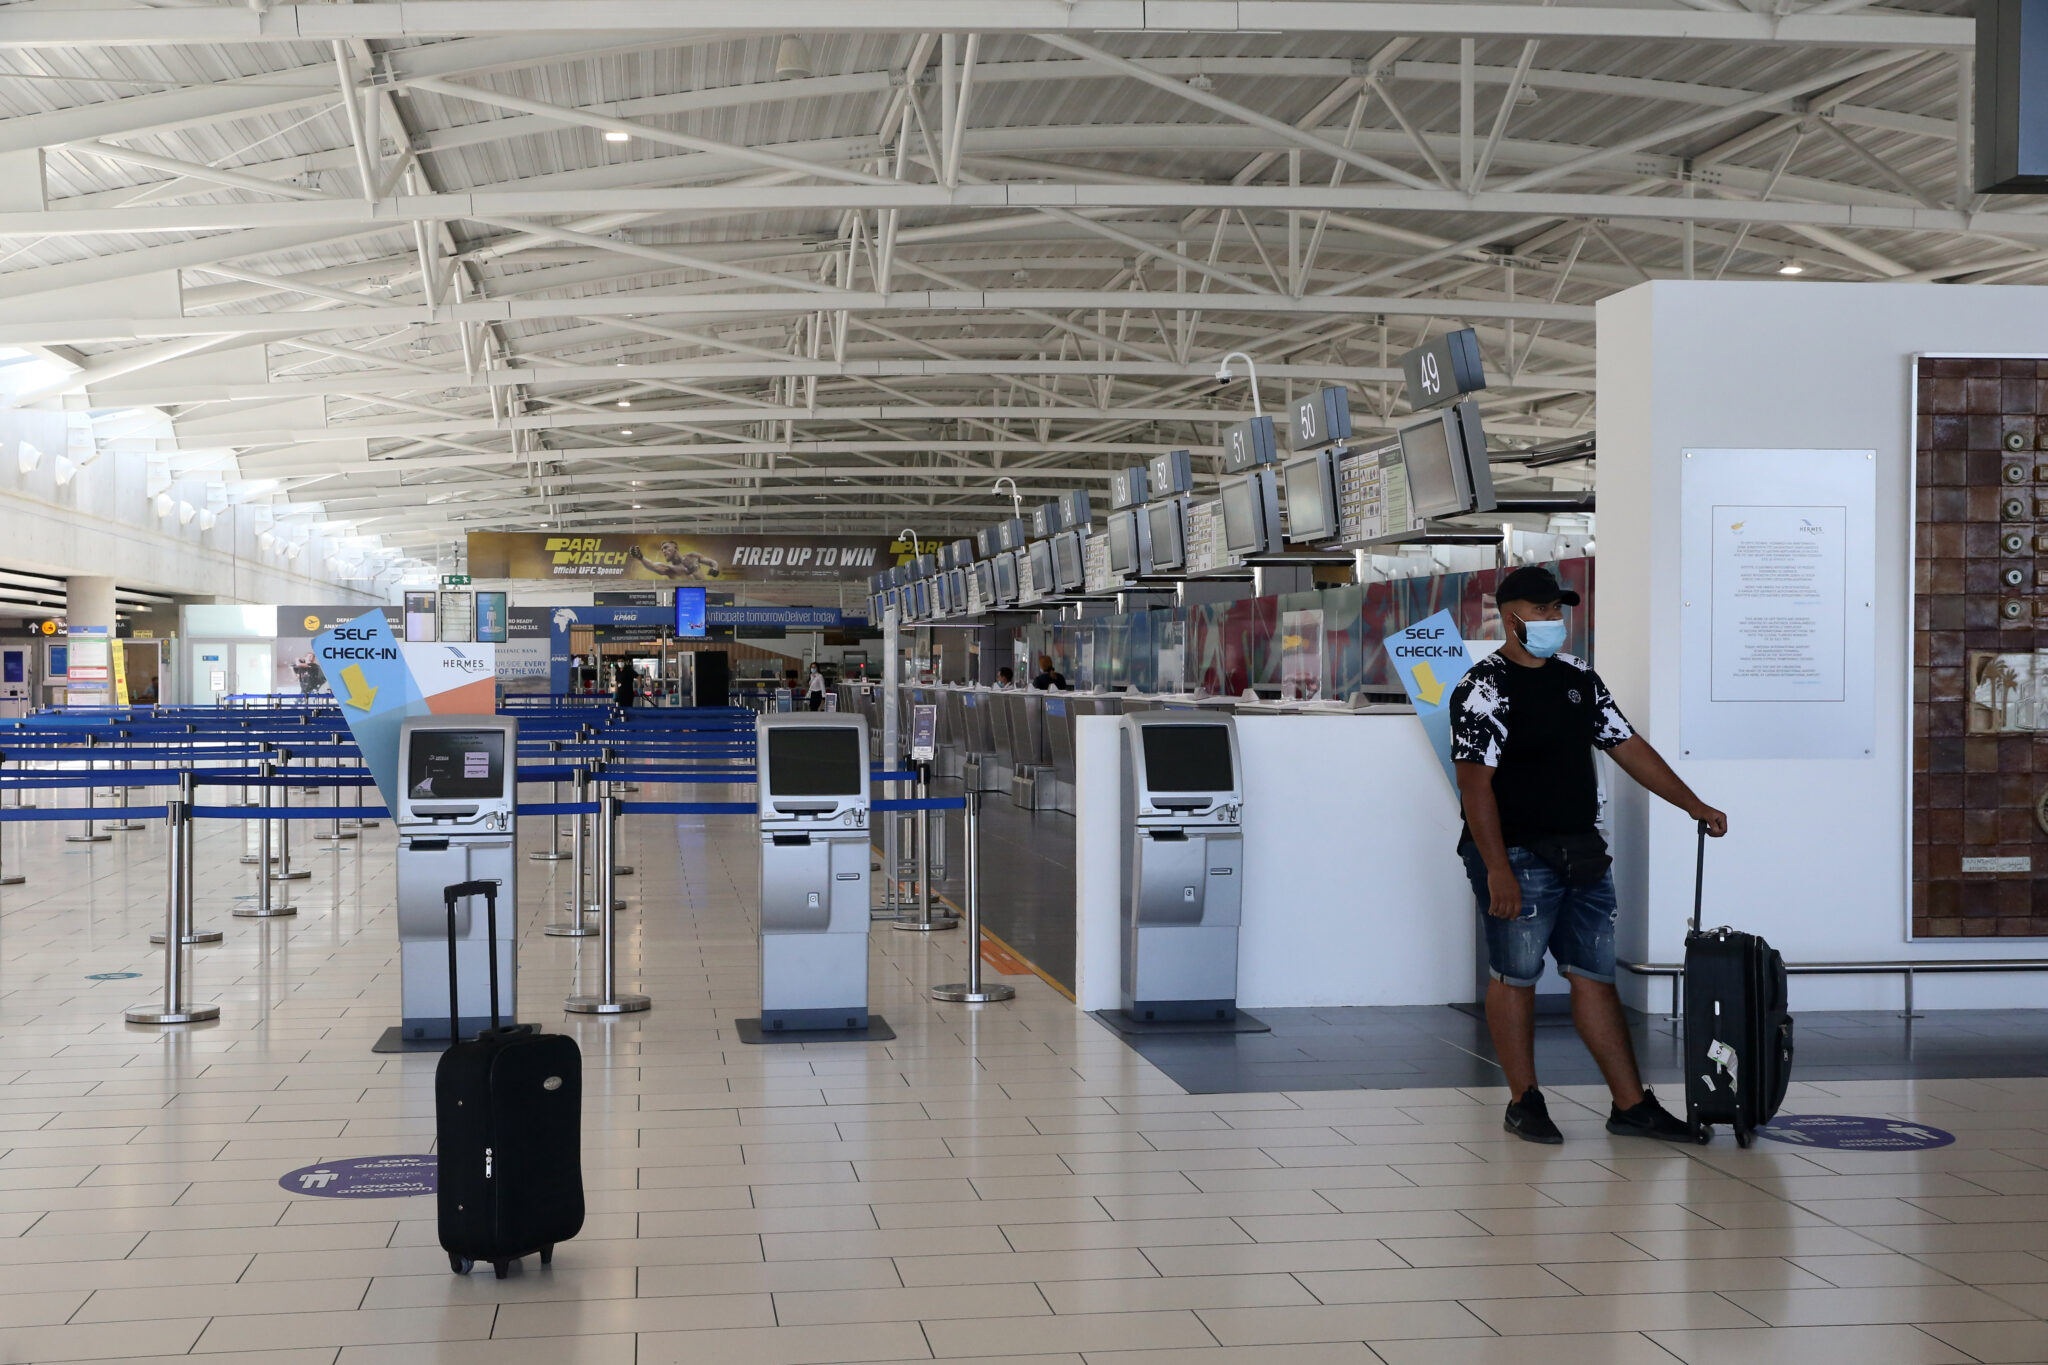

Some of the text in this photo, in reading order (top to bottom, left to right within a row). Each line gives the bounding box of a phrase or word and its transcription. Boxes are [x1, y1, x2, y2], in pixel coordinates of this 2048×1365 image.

[1421, 352, 1440, 396] 49
[1300, 402, 1316, 440] 50
[1232, 430, 1245, 463] 51
[1157, 462, 1168, 490] 52
[1117, 476, 1126, 503] 53
[549, 538, 601, 551] PARI
[556, 552, 629, 564] MATCH
[732, 546, 877, 567] FIRED UP TO WIN
[553, 566, 624, 576] Official UFC Sponsor
[613, 613, 638, 621] KPMG
[706, 611, 745, 624] Anticipate
[813, 611, 836, 624] today
[333, 628, 378, 640] SELF
[1405, 628, 1445, 640] SELF
[322, 647, 397, 660] CHECK-IN
[1395, 646, 1463, 657] CHECK-IN
[443, 659, 484, 671] HERMES
